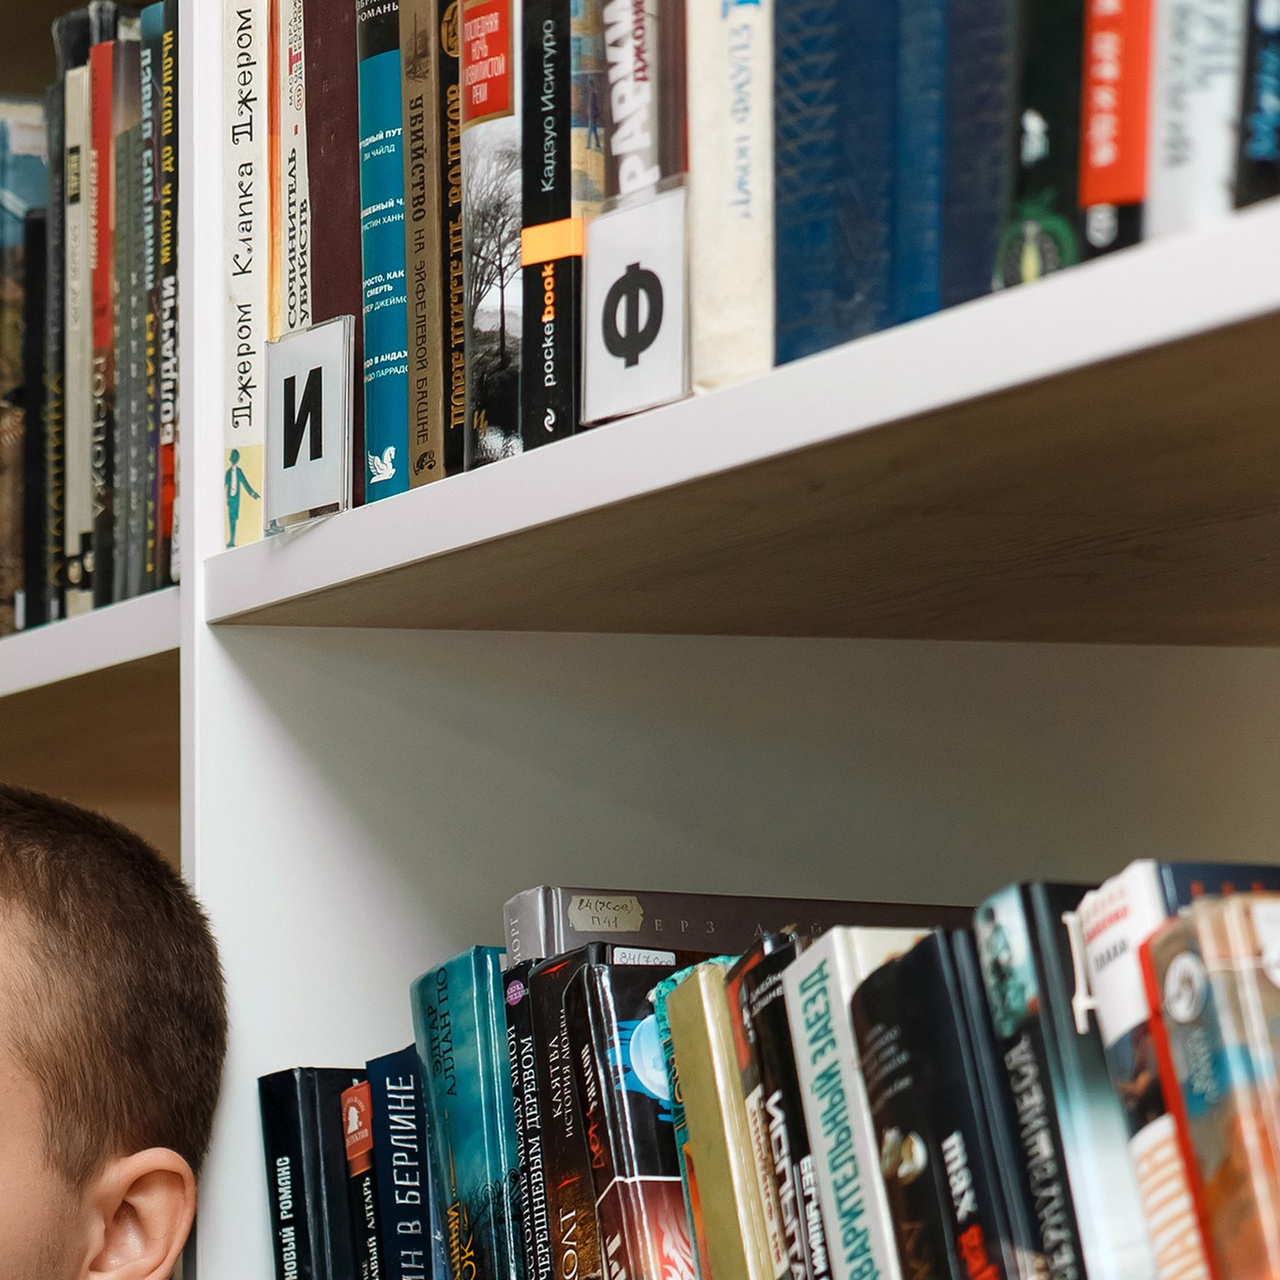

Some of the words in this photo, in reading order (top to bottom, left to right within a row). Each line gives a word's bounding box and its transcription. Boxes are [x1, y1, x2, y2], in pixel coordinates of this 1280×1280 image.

[231, 9, 257, 145] Джером
[540, 19, 557, 111] Исигуро
[408, 95, 426, 222] УБИЙСТВО
[540, 116, 557, 191] Кадзуо
[231, 162, 254, 275] Клапка
[287, 148, 298, 329] СОЧИНИТЕЛЬ
[297, 199, 309, 325] УБИЙСТВ
[413, 229, 425, 253] НА
[386, 270, 405, 280] КАК
[414, 260, 428, 370] ЭЙФЕЛЕВОЙ
[601, 261, 663, 367] Ф
[231, 304, 256, 427] Джером
[415, 378, 429, 445] БАШНЕ
[283, 366, 323, 469] И
[436, 967, 451, 1002] ПО
[796, 959, 833, 1061] ЗАЕЗД
[436, 1011, 457, 1096] АЛЛАН
[520, 1036, 541, 1130] ДЕРЕВОМ
[549, 1036, 563, 1119] КЛЯТВА
[563, 1066, 575, 1138] ИСТОРИЯ
[385, 1074, 421, 1205] БЕРЛИНЕ
[941, 1131, 977, 1222] max
[361, 1177, 376, 1230] АЛТАРЬ
[397, 1219, 422, 1234] В
[528, 1137, 551, 1280] ЧЕРЕШНЕВЫМ
[798, 1155, 825, 1275] БЕГУЩИЙ
